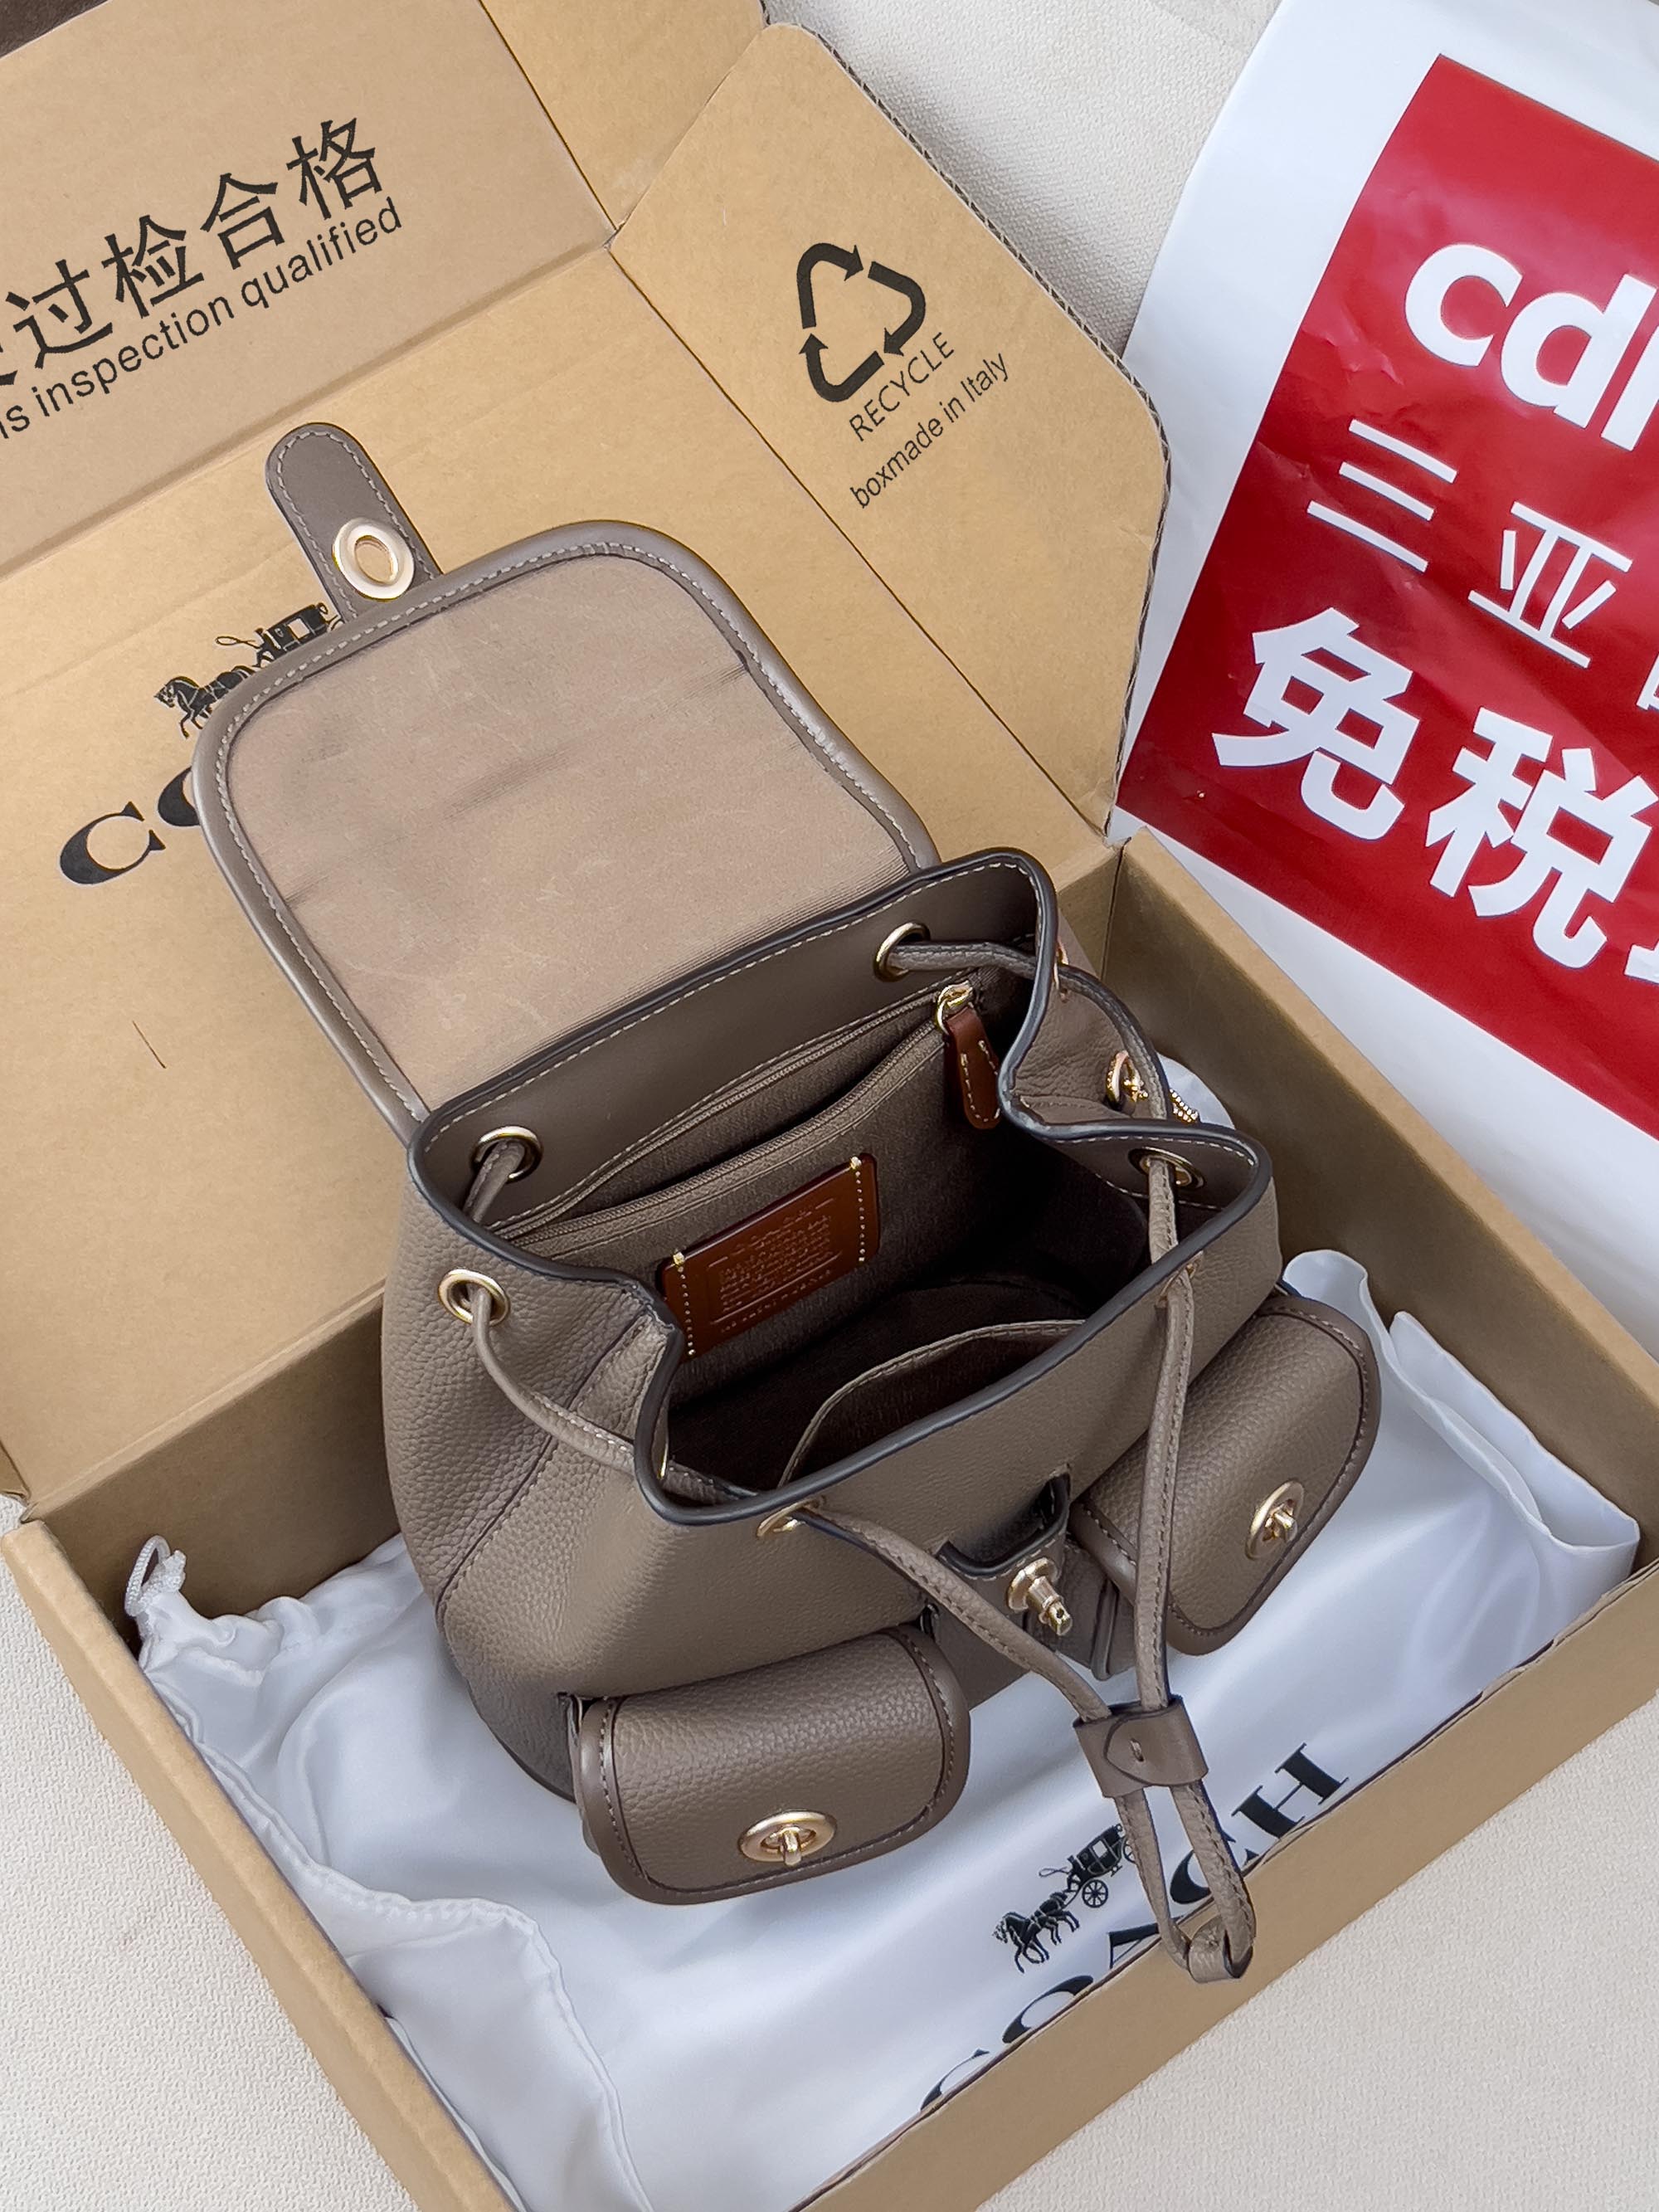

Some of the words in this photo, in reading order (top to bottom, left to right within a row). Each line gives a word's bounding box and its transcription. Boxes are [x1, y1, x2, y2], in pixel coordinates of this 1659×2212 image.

[0, 118, 382, 386] 过检合格
[32, 295, 235, 417] inspection
[241, 197, 401, 309] qualified
[849, 333, 954, 441] RECYCLE
[939, 396, 966, 423] in
[961, 353, 1009, 402] Italy
[1307, 419, 1659, 710] 三亚
[1212, 607, 1659, 986] 免税
